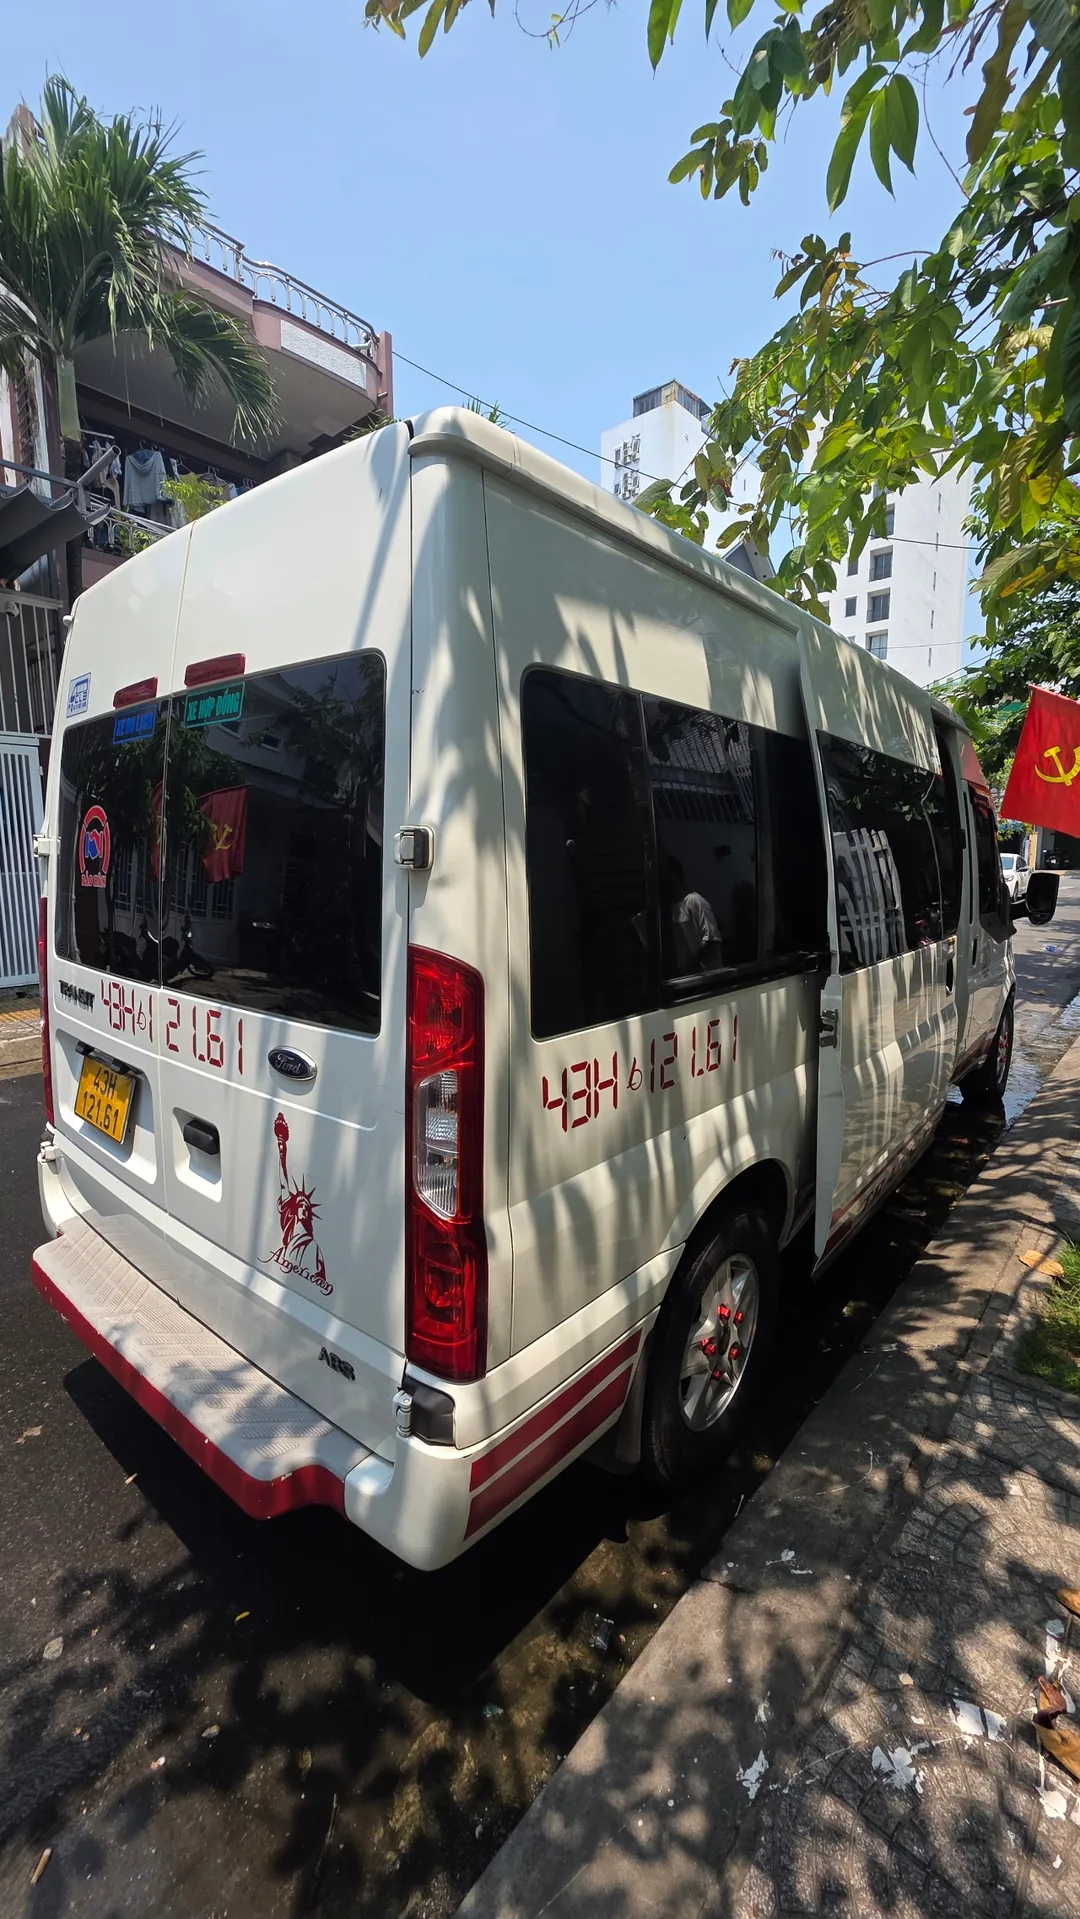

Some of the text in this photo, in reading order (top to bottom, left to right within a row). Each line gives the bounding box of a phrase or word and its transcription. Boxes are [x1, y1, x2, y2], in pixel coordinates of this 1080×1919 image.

[187, 688, 240, 722] XE HỢP ĐỒNG
[275, 1052, 302, 1075] Ford
[650, 1014, 738, 1094] 121.61
[92, 1066, 118, 1099] 43H
[83, 1091, 119, 1136] 121.61
[257, 1246, 334, 1296] American
[318, 1346, 356, 1381] ABS
